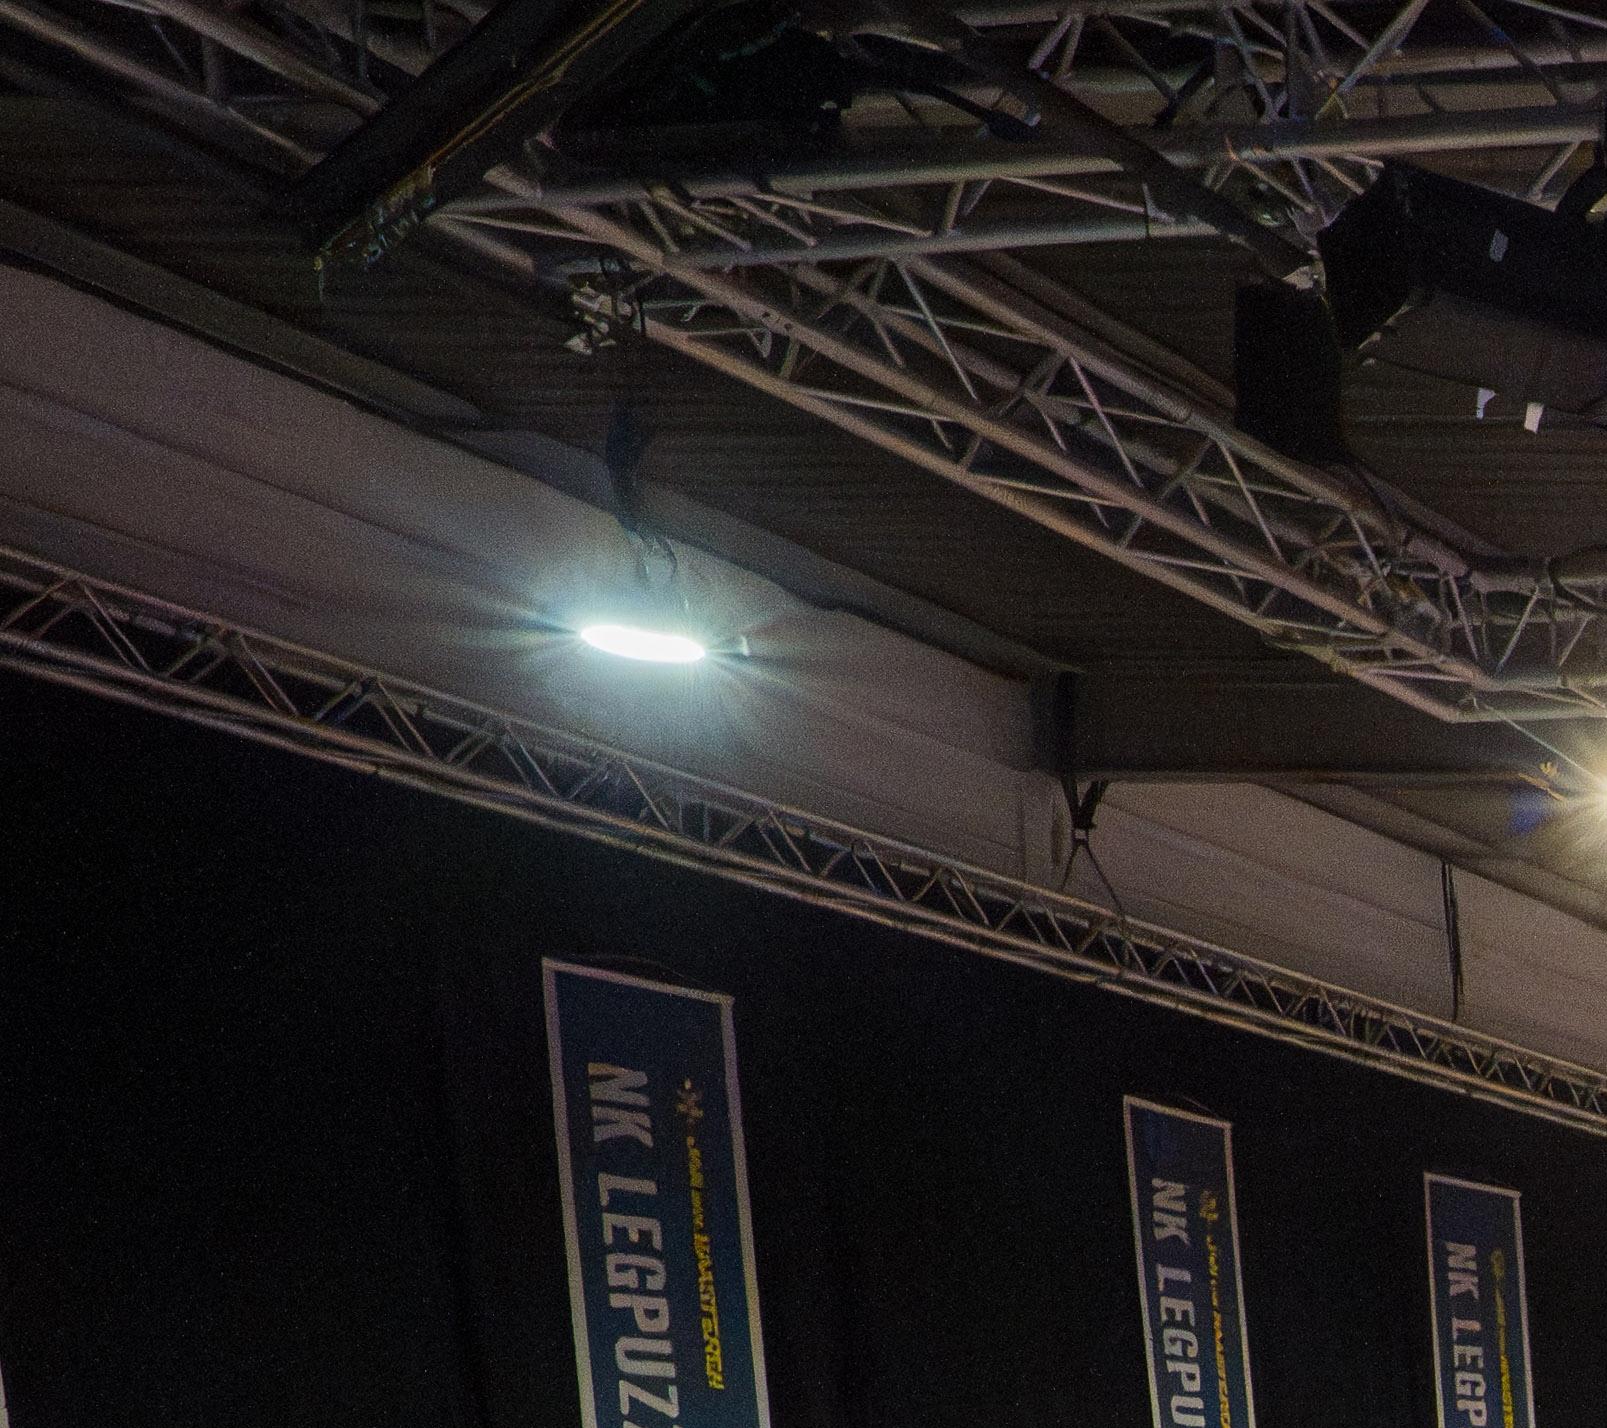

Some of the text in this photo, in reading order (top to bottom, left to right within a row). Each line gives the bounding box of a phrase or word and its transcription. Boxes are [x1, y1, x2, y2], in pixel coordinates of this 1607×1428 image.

[588, 1062, 653, 1145] NK
[1151, 1178, 1189, 1248] NK
[1445, 1241, 1478, 1298] NK
[692, 1234, 725, 1391] HAASTEREN
